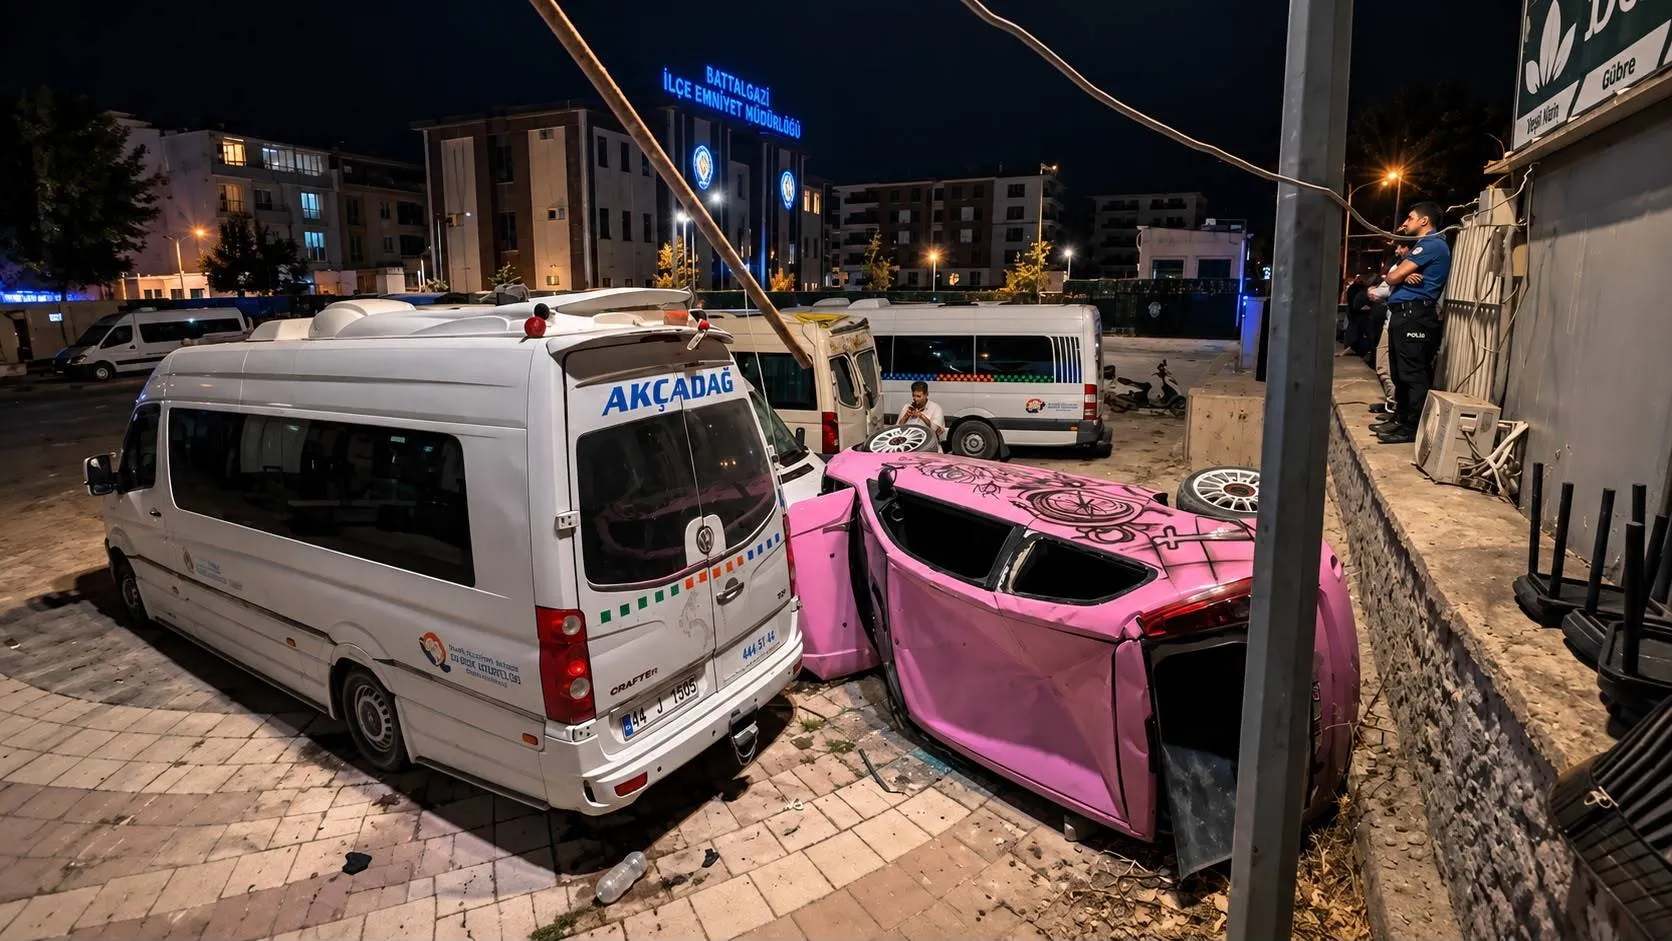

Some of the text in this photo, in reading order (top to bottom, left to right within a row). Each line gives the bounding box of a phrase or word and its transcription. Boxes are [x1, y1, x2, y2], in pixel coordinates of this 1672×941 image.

[663, 67, 692, 99] İLÇE
[695, 85, 743, 118] EMNİYET
[706, 65, 770, 107] BATTALGAZİ
[601, 367, 733, 416] AKÇADAĞ
[743, 643, 756, 660] 444
[610, 667, 658, 696] CRAFTER
[632, 677, 697, 727] 44 J 1505
